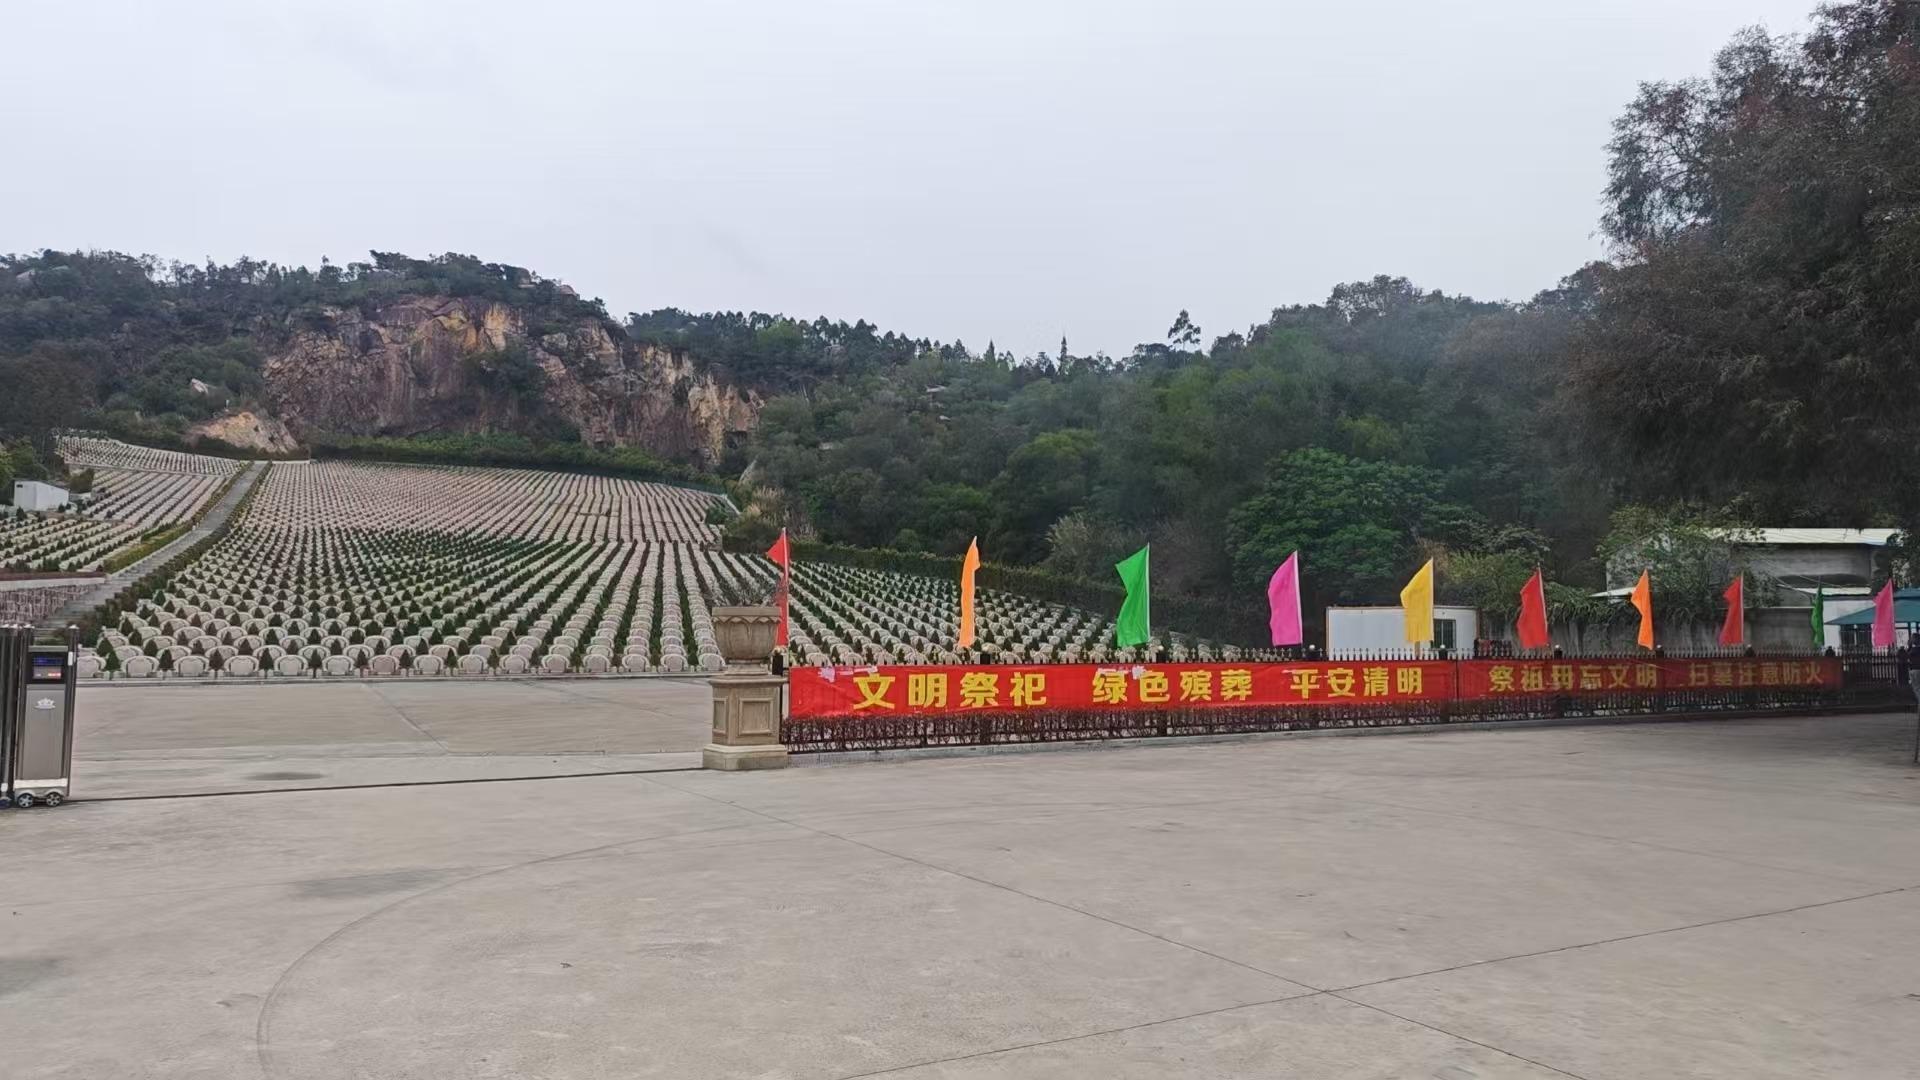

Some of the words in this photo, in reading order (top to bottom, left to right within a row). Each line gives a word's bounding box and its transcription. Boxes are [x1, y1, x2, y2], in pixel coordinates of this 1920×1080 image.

[853, 671, 1047, 709] 文明祭祀
[1092, 669, 1252, 704] 绿色殡葬
[1290, 667, 1423, 699] 平安清明
[1688, 661, 1823, 686] 扫墓注意防火
